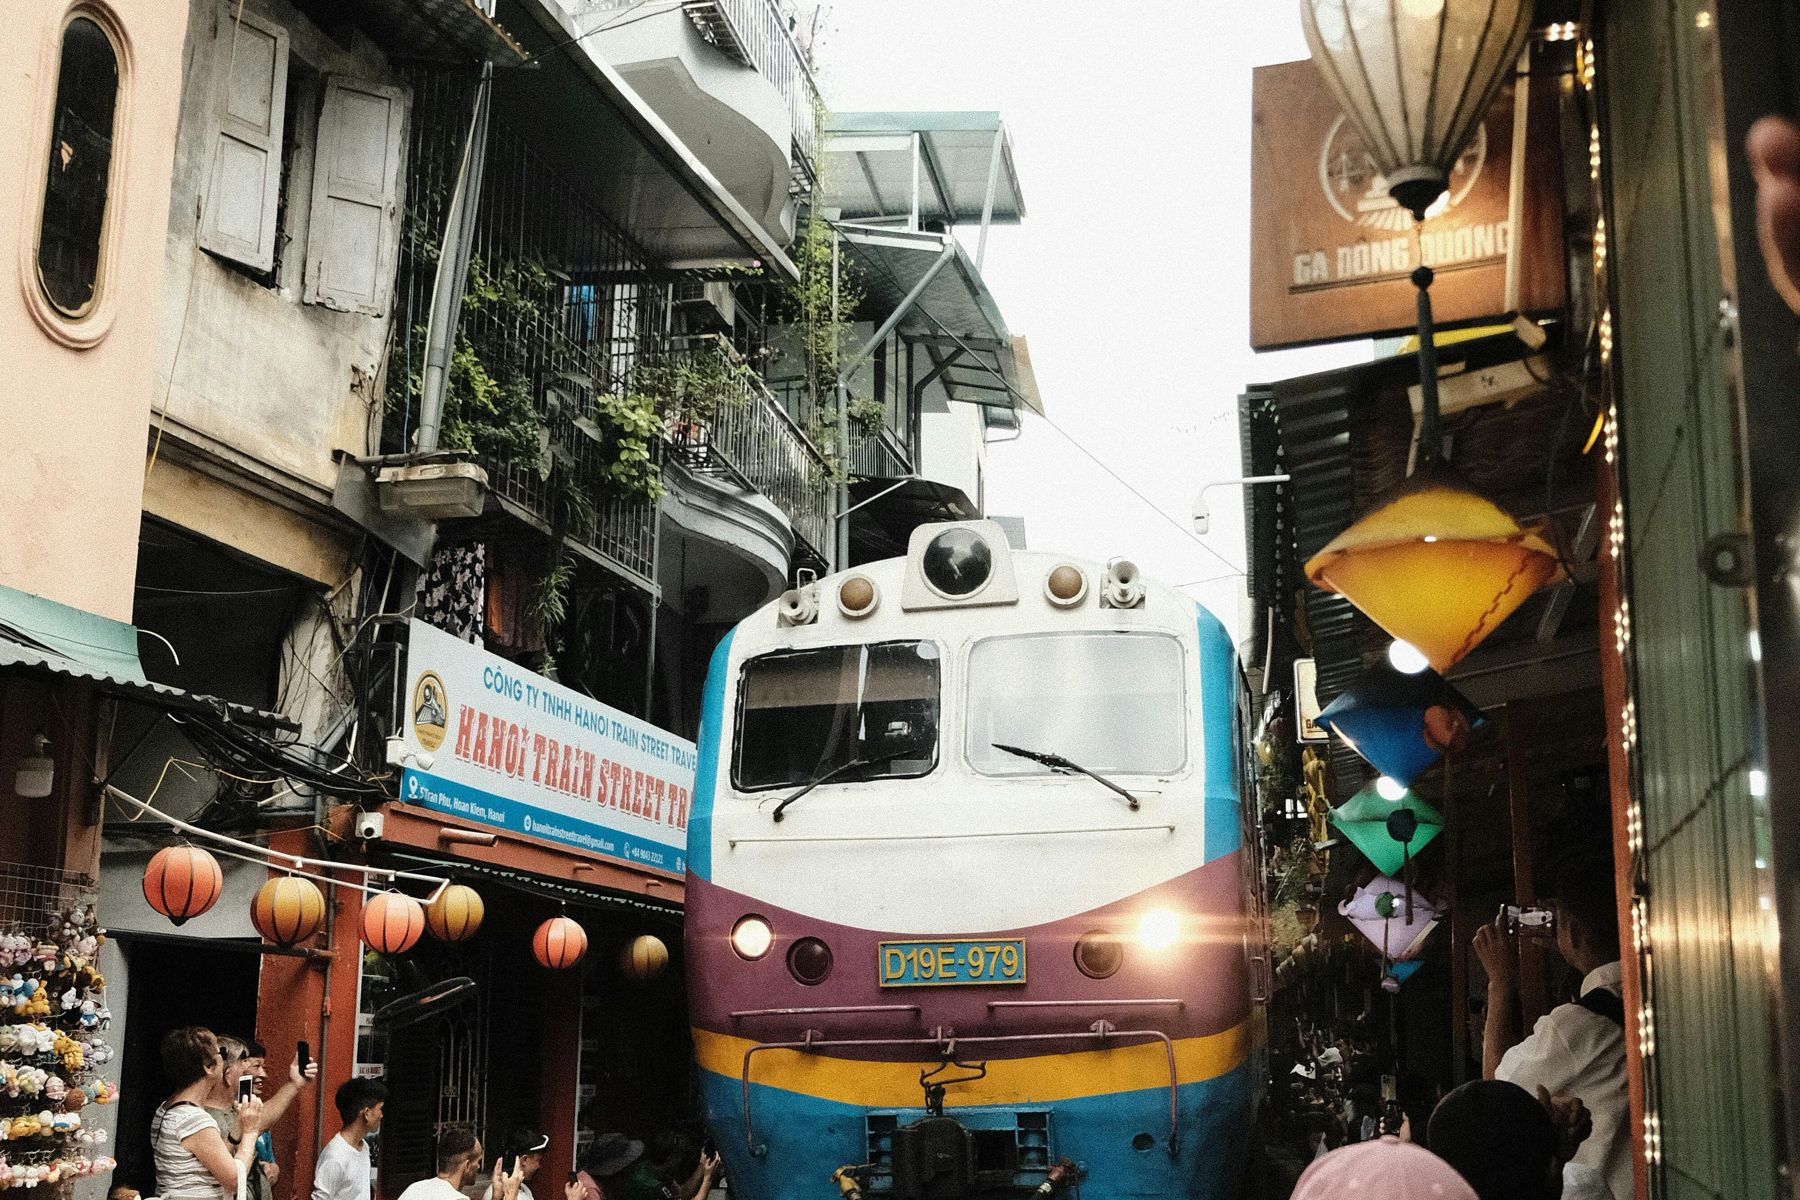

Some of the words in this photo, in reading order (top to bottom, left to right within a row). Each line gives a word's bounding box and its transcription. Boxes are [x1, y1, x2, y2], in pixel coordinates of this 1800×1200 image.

[1294, 251, 1328, 284] GA
[483, 666, 523, 702] CÔNG
[526, 684, 539, 708] TY
[542, 691, 572, 722] TNHH
[575, 705, 609, 737] HANOI
[611, 721, 639, 750] TRAIN
[641, 733, 669, 761] STREET
[453, 797, 470, 813] Hoan
[597, 758, 665, 824] STREET
[884, 945, 1019, 979] D19E-979
